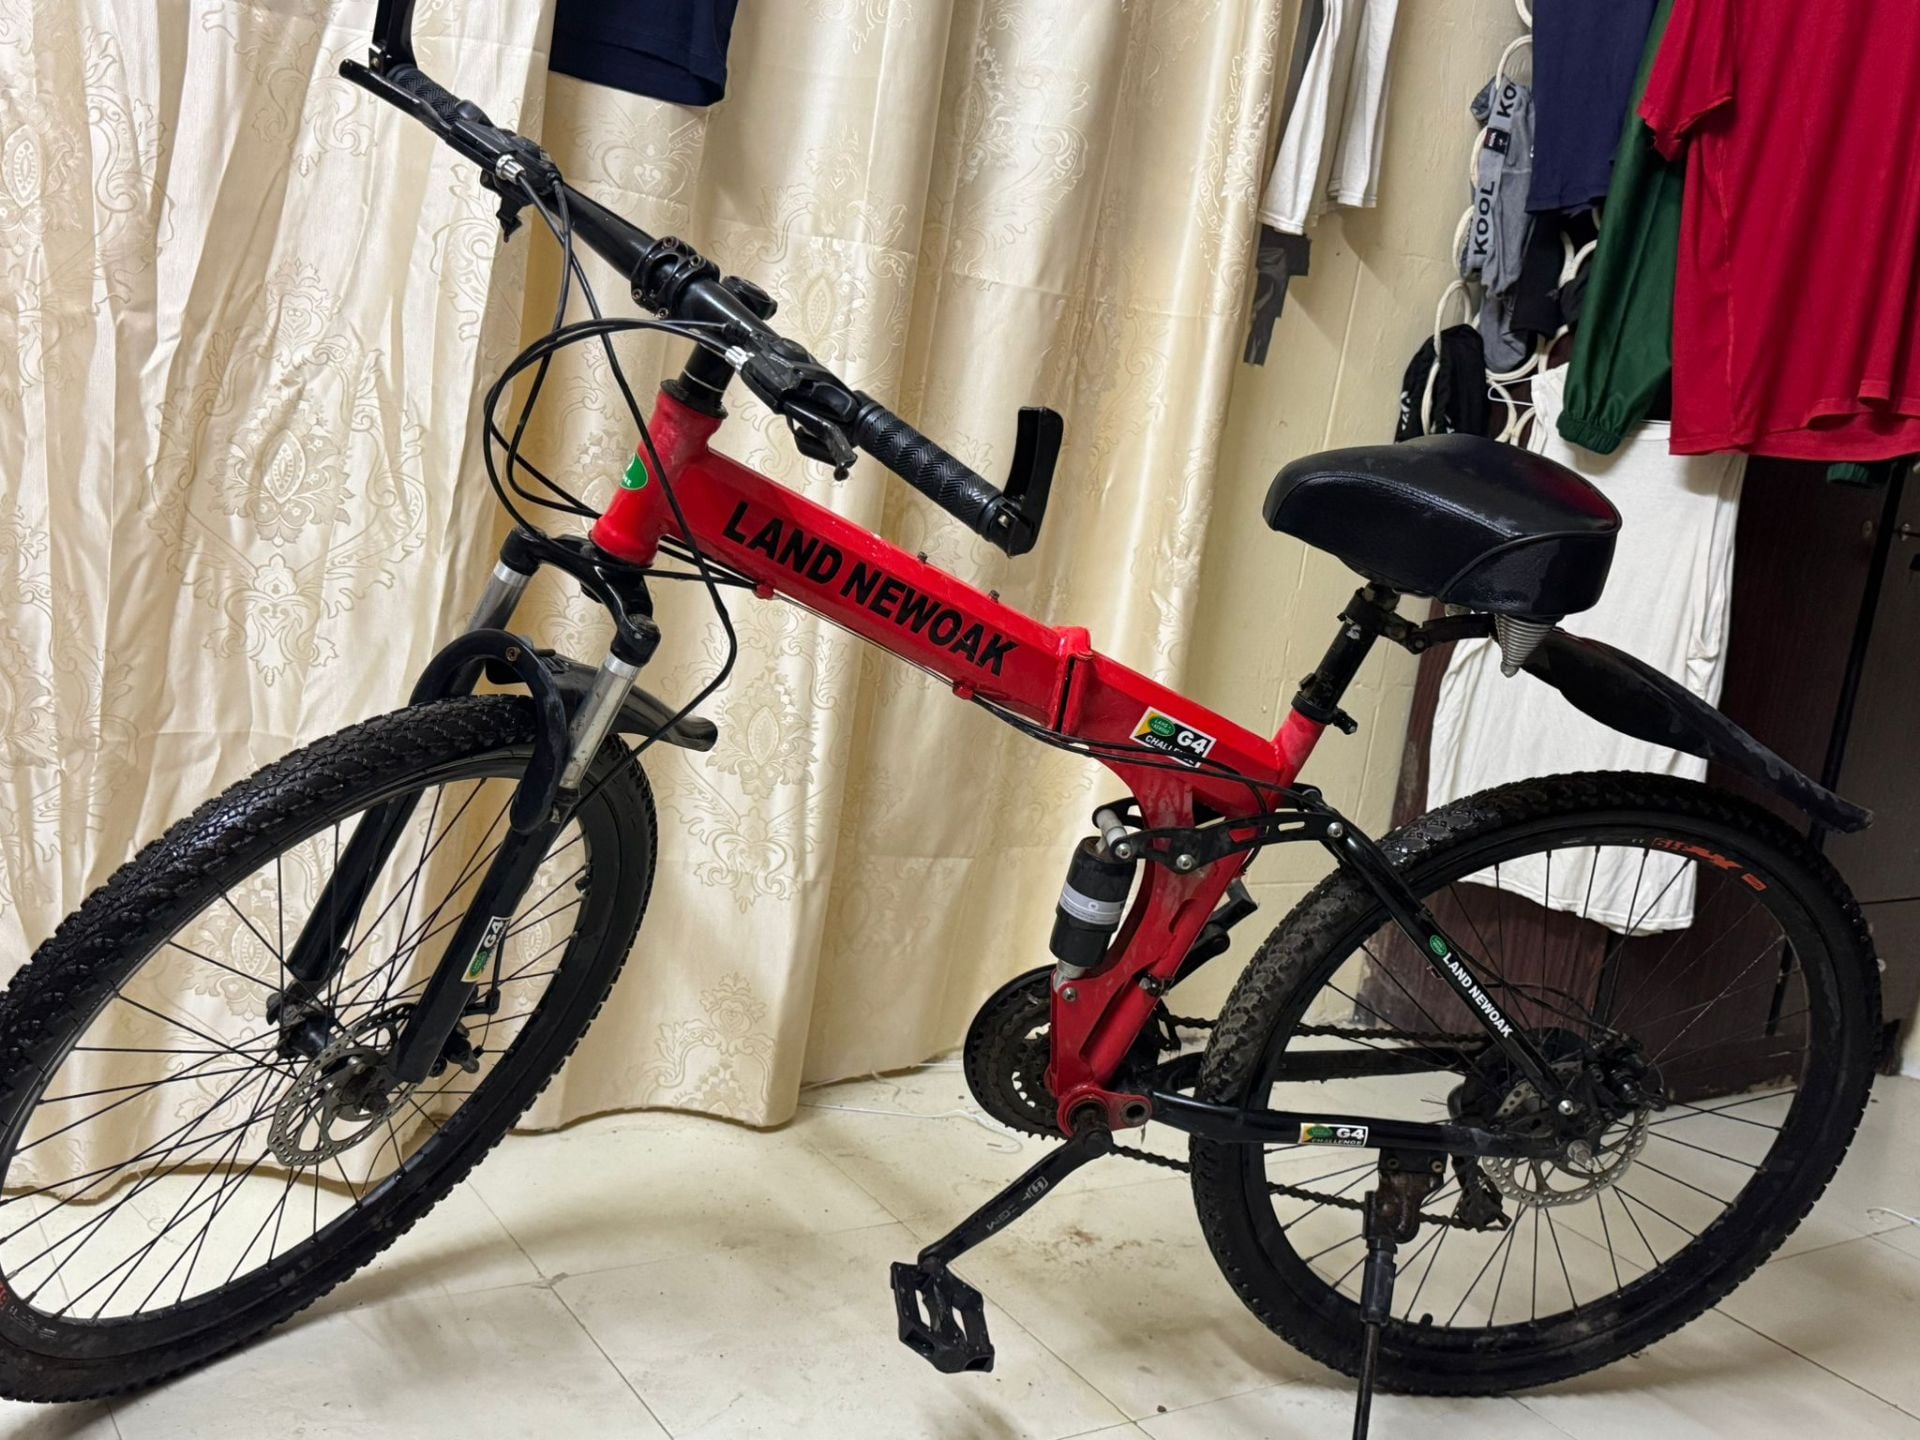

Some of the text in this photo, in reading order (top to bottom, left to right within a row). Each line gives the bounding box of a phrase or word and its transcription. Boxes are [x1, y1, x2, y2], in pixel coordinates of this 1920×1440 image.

[1474, 181, 1495, 255] KOOL
[722, 502, 1019, 676] LAND NEWOAK
[1177, 731, 1208, 754] G4
[484, 921, 504, 948] G4
[1443, 952, 1513, 1038] LAND NEWOAK
[1336, 1128, 1364, 1139] G4
